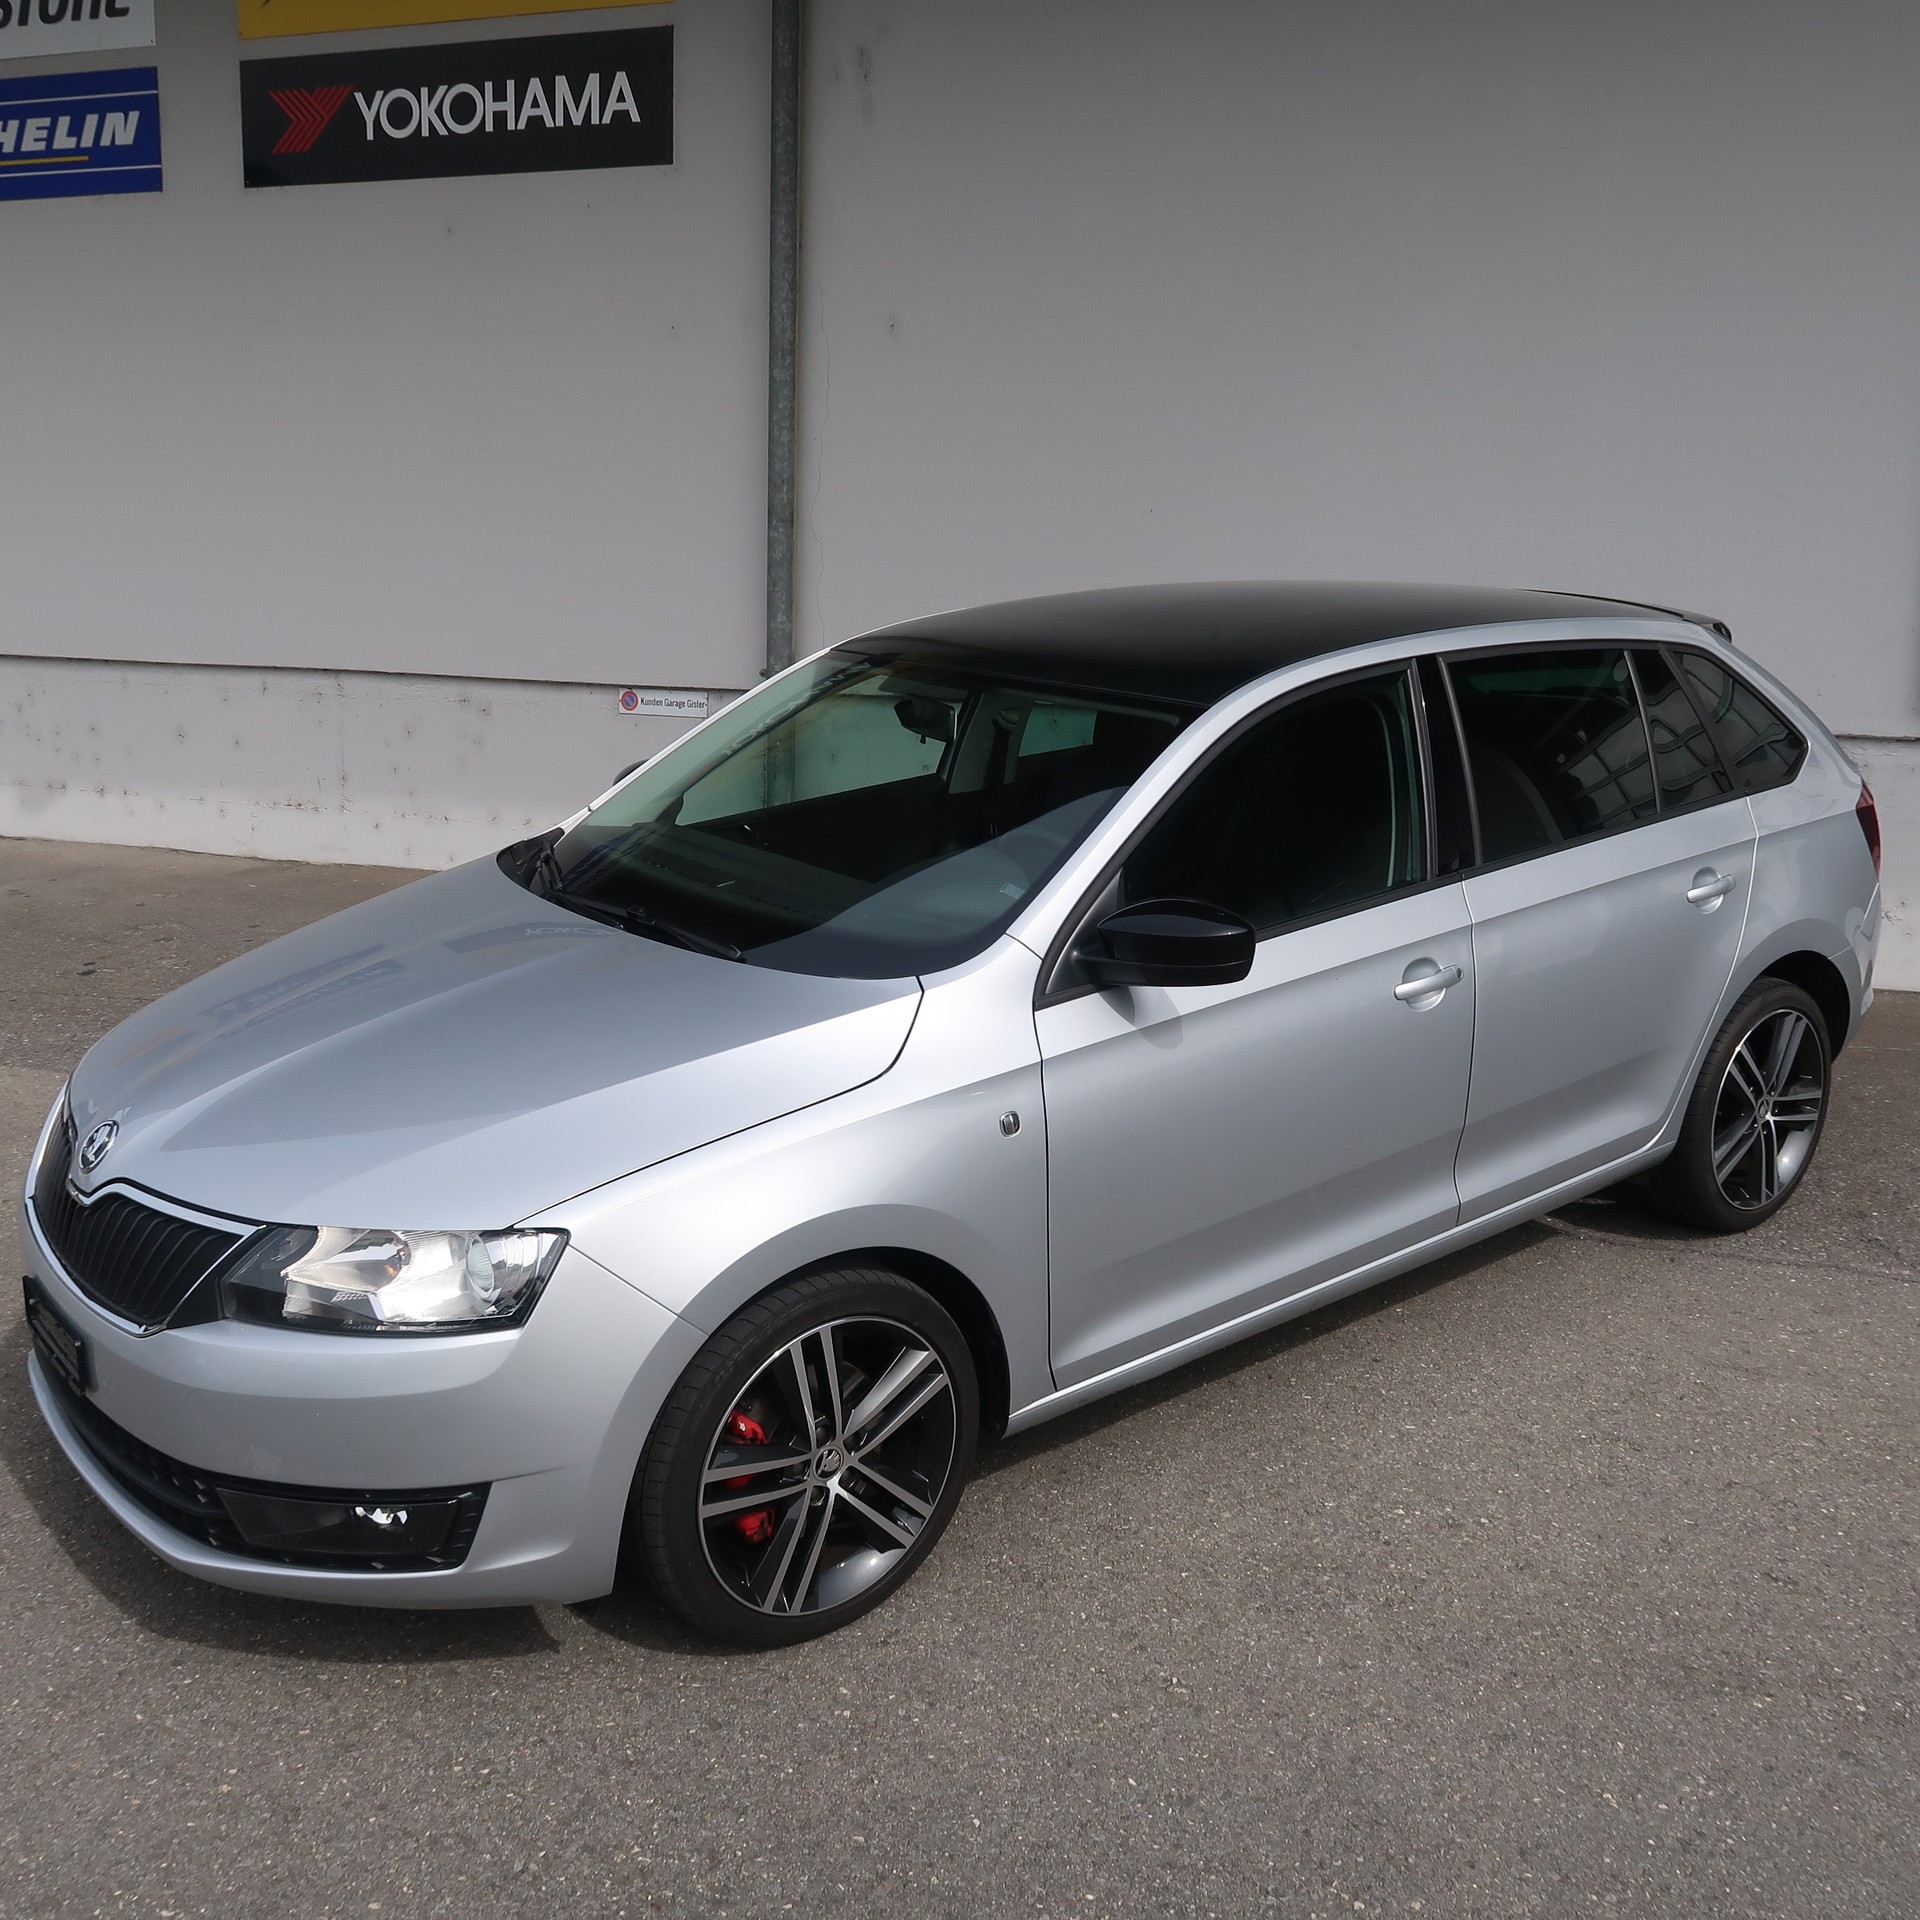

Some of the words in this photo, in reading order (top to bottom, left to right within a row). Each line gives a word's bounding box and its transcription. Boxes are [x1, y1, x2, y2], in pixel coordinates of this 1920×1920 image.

[353, 71, 641, 141] YOKOHAMA
[640, 697, 664, 707] Kunden
[664, 698, 686, 709] Garage
